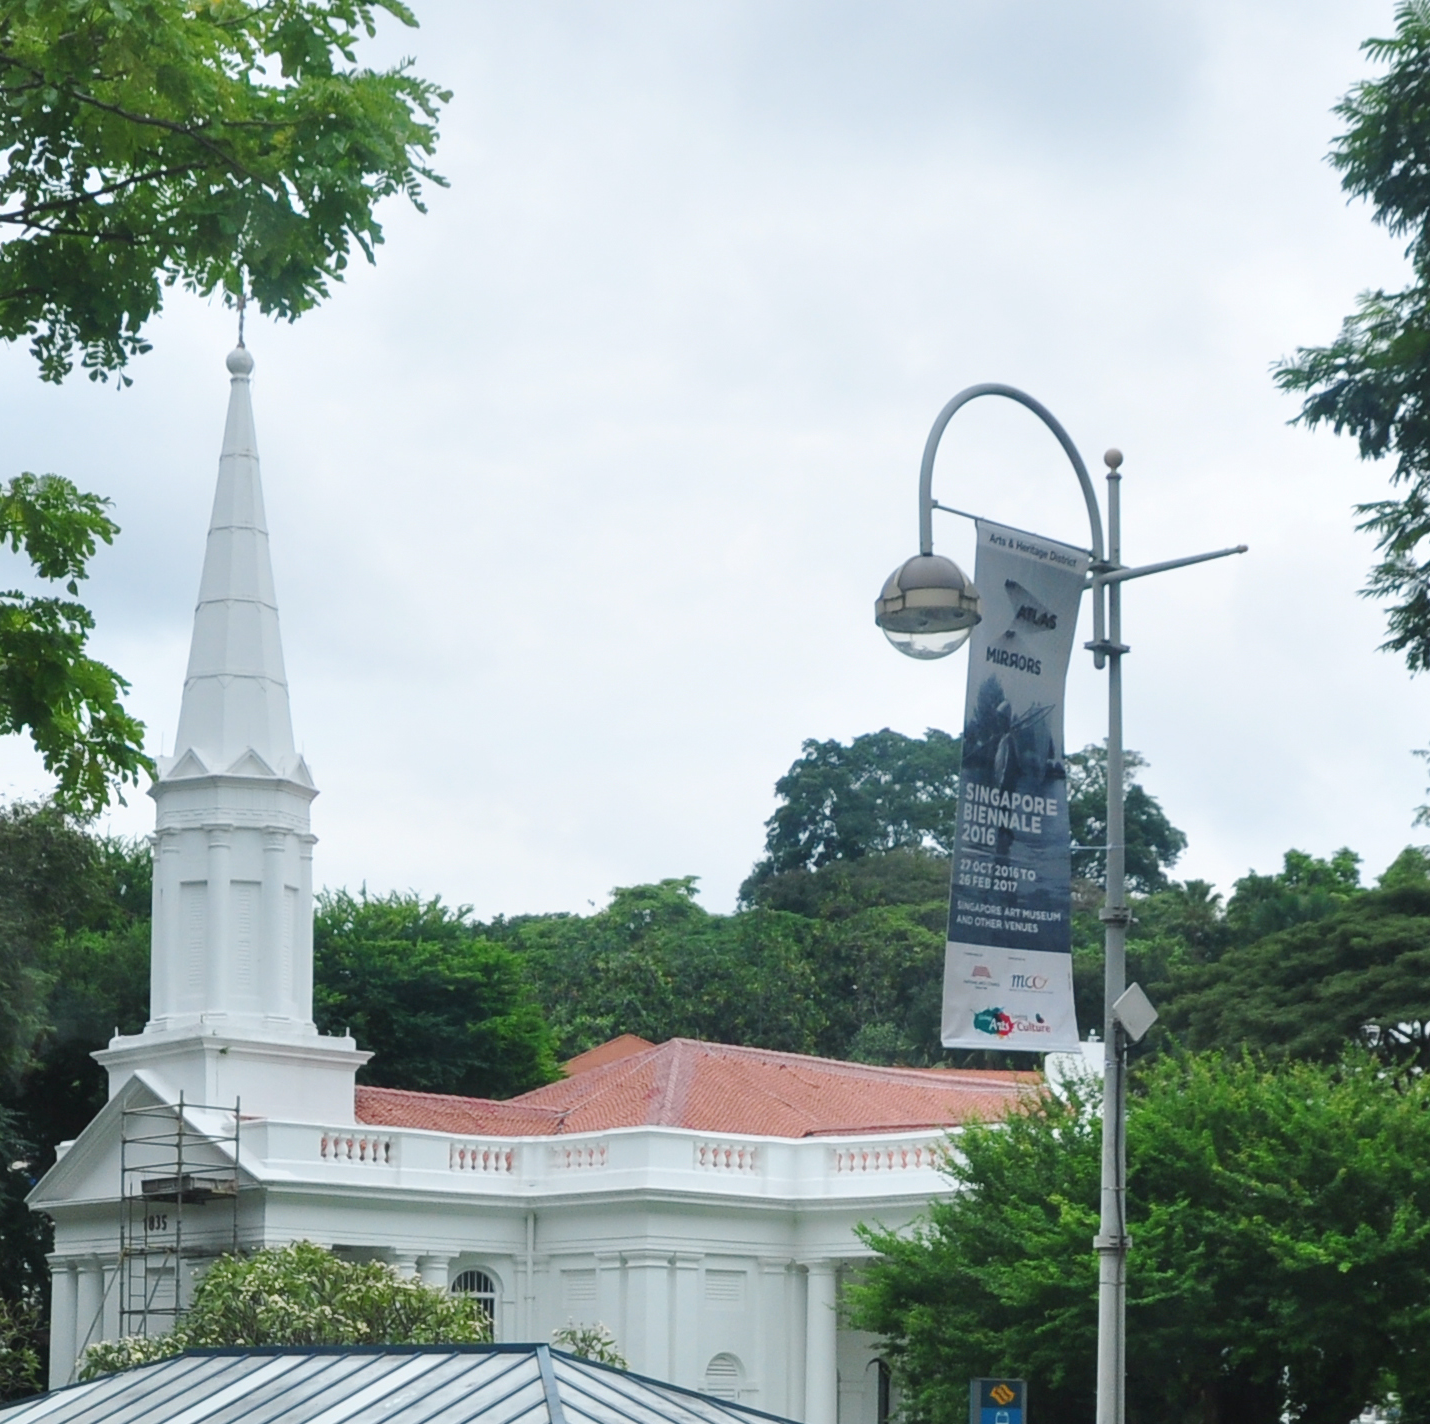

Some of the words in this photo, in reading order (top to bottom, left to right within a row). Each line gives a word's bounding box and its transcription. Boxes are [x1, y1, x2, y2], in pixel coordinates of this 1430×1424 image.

[989, 533, 1007, 549] Arts
[1008, 539, 1015, 549] &
[1016, 540, 1049, 560] Heritage
[1050, 550, 1077, 568] District
[1016, 605, 1058, 630] ATLAS
[965, 782, 1058, 816] SINGAPORE
[963, 802, 1042, 834] BIENNALE
[961, 824, 995, 846] 2016
[960, 858, 971, 870] 27
[973, 861, 992, 874] OCT
[995, 864, 1019, 878] 2016
[1020, 868, 1036, 881] TO
[959, 873, 971, 886] 26
[973, 876, 991, 889] FEB
[993, 878, 1018, 892] 2017
[957, 901, 1002, 915] SINGAPORE
[1004, 907, 1021, 918] ART
[1023, 909, 1061, 922] MUSEUM
[956, 914, 973, 926] AND
[975, 917, 1002, 930] OTHER
[1005, 920, 1039, 934] VENUES
[1017, 1021, 1051, 1033] Culture
